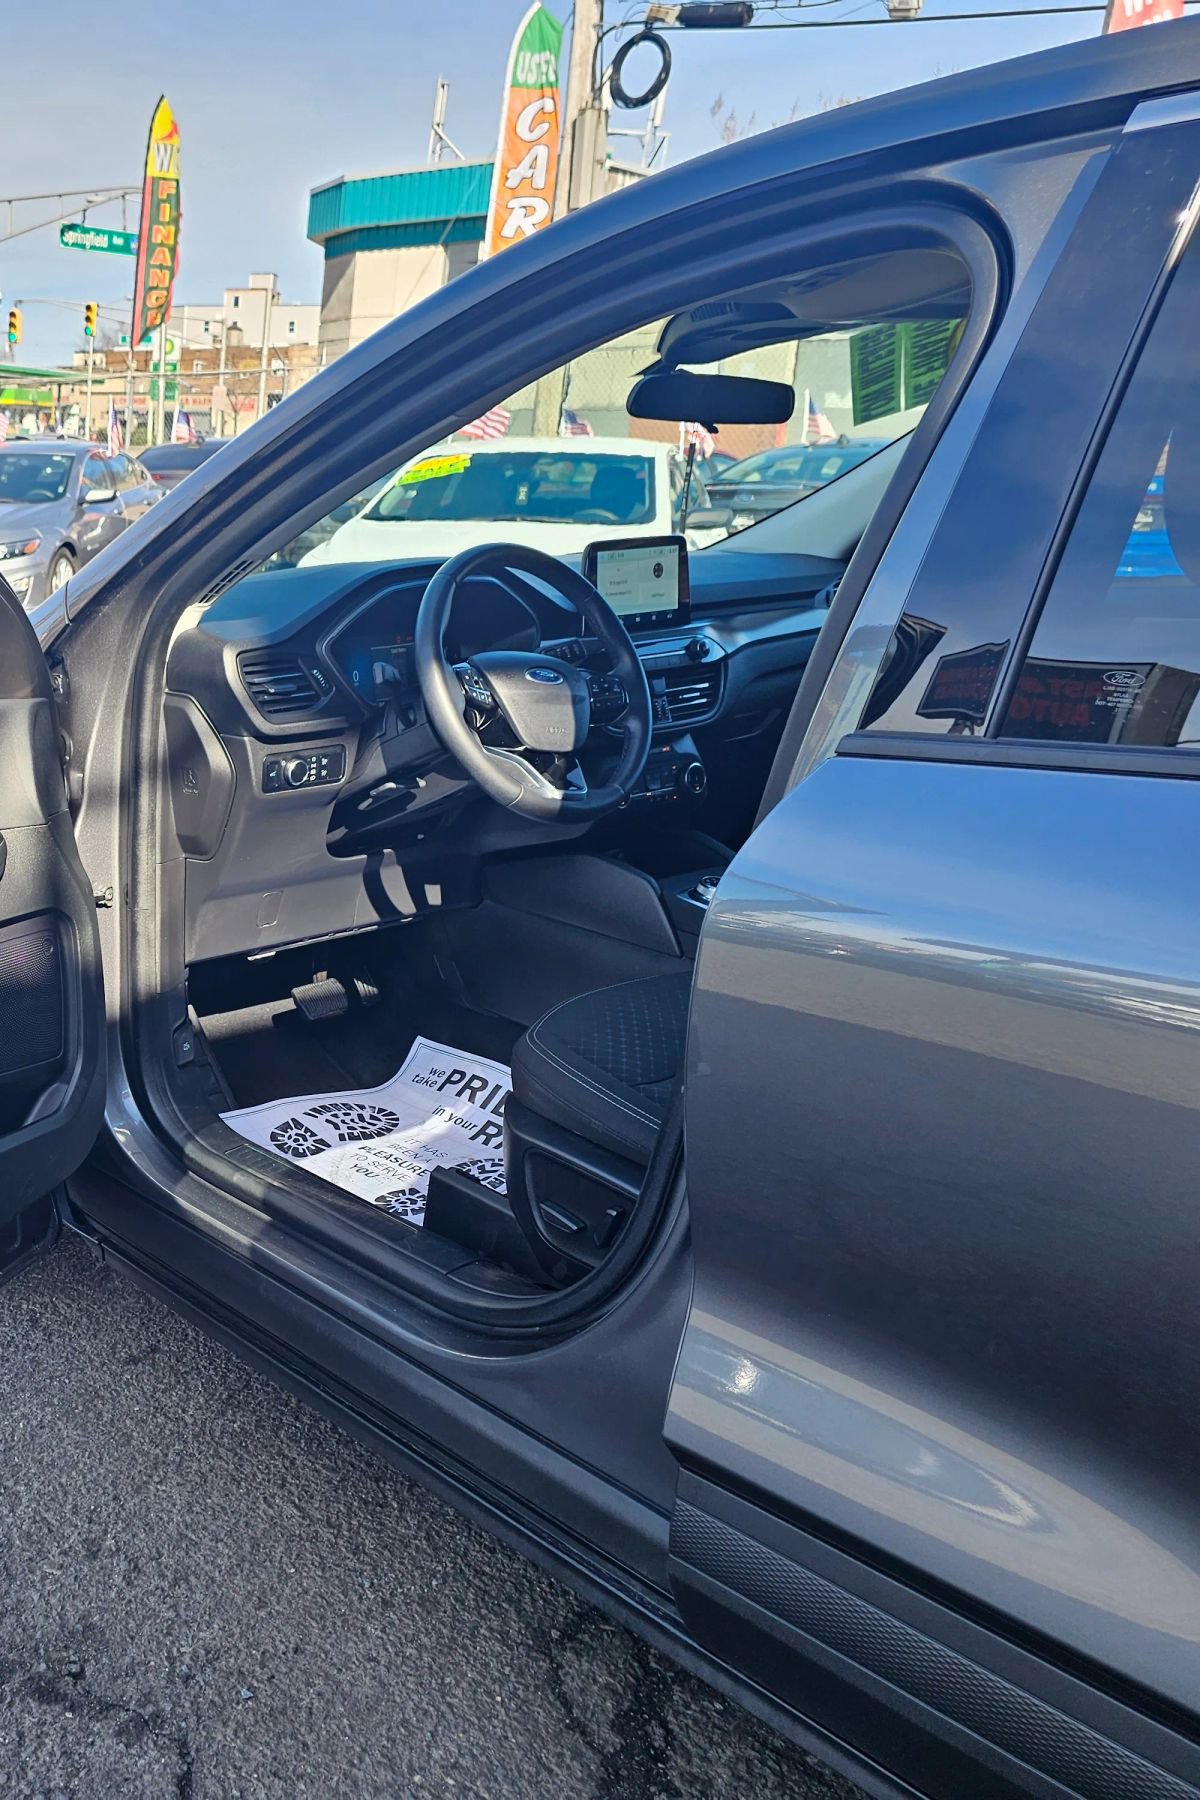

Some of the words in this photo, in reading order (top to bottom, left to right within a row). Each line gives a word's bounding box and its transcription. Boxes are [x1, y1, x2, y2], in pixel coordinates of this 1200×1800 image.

[1111, 672, 1138, 684] Ford
[428, 1067, 446, 1078] we
[411, 1074, 438, 1088] take
[432, 1104, 445, 1117] in
[444, 1112, 478, 1131] your
[387, 1143, 423, 1159] BEEN
[419, 1144, 448, 1159] HAS
[350, 1152, 368, 1162] TO
[367, 1159, 412, 1182] SERVE
[358, 1145, 432, 1177] PLEASURE
[350, 1163, 380, 1178] YOU
